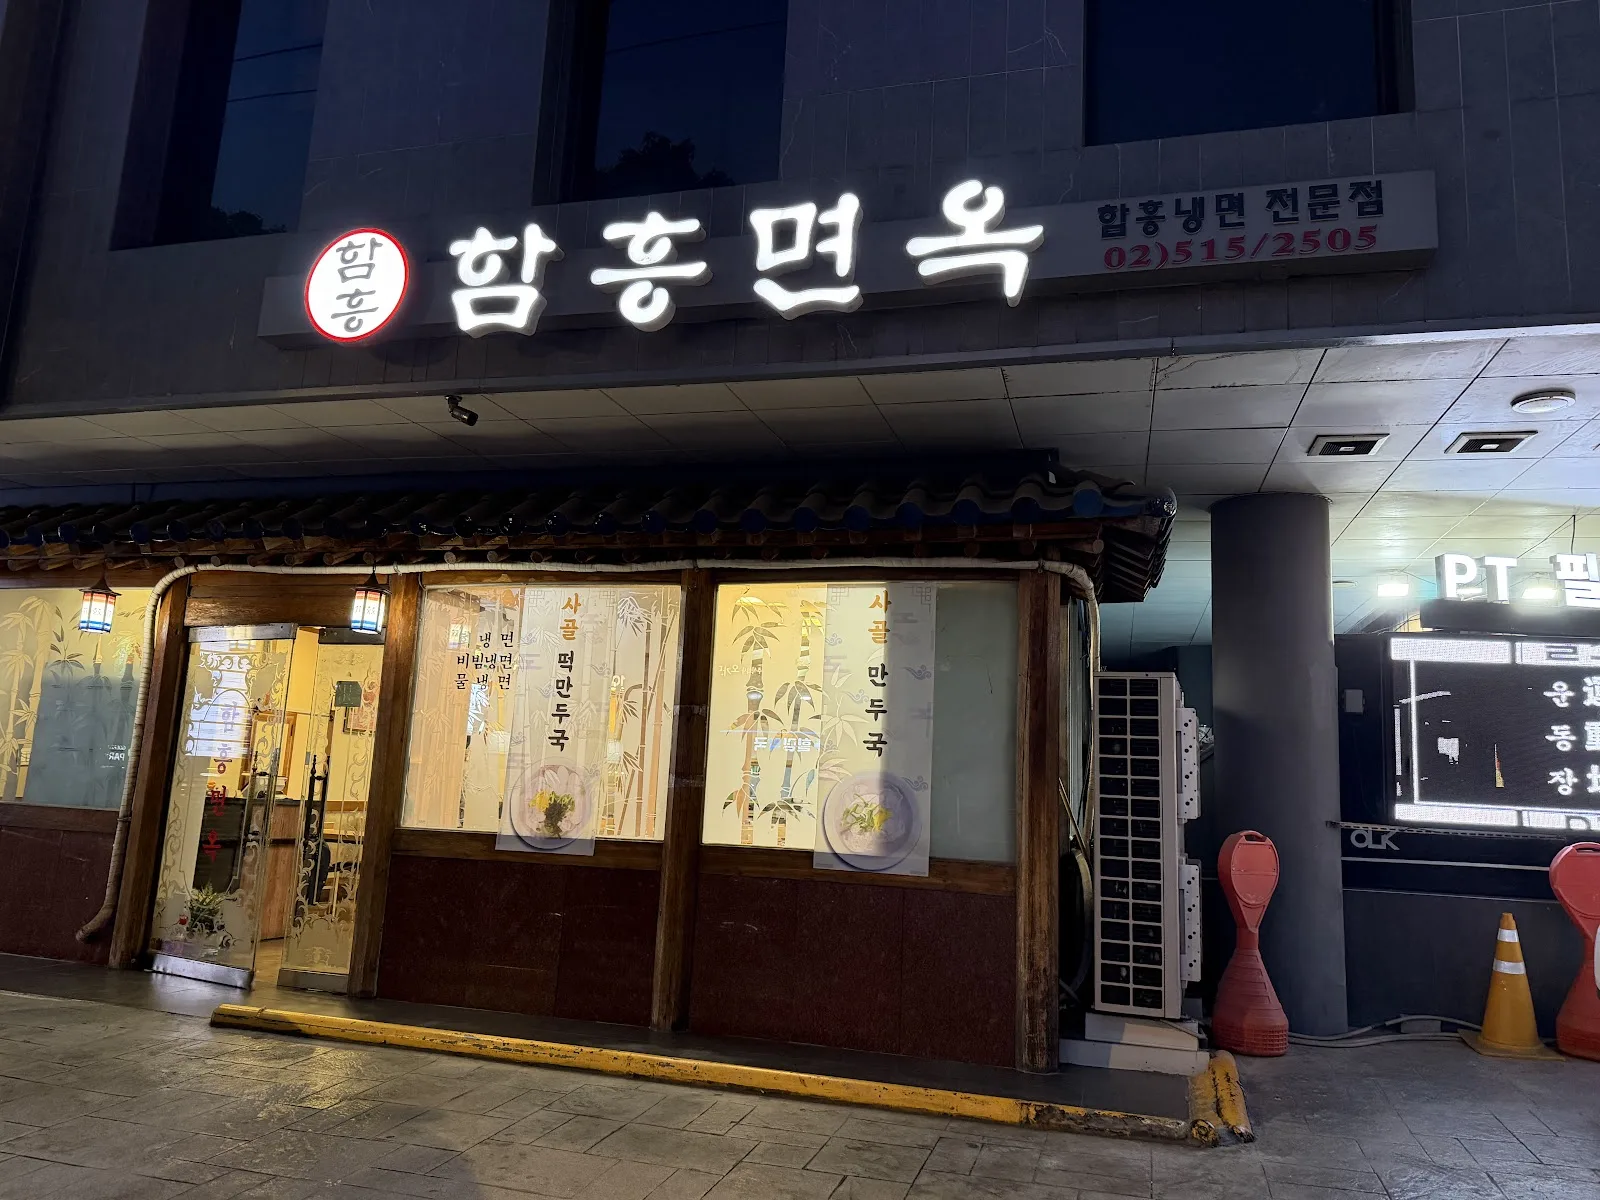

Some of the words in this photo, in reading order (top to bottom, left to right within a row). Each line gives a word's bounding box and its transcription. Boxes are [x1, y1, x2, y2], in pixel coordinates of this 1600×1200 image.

[1096, 191, 1246, 240] 함흥냉면
[1264, 178, 1385, 226] 전문점
[449, 178, 1046, 337] 함흥면옥
[1103, 223, 1379, 270] 02)515/2505
[330, 237, 384, 333] 함흥
[1438, 553, 1518, 604] PT
[479, 631, 514, 648] 냉면
[559, 592, 582, 641] 사골
[867, 590, 892, 645] 사골
[454, 673, 511, 690] 물냉면
[456, 652, 512, 669] 비빔냉면
[548, 650, 575, 752] 떡만두국
[862, 662, 889, 758] 만두국
[1543, 680, 1579, 796] 운동장
[202, 700, 240, 864] 함흥면옥
